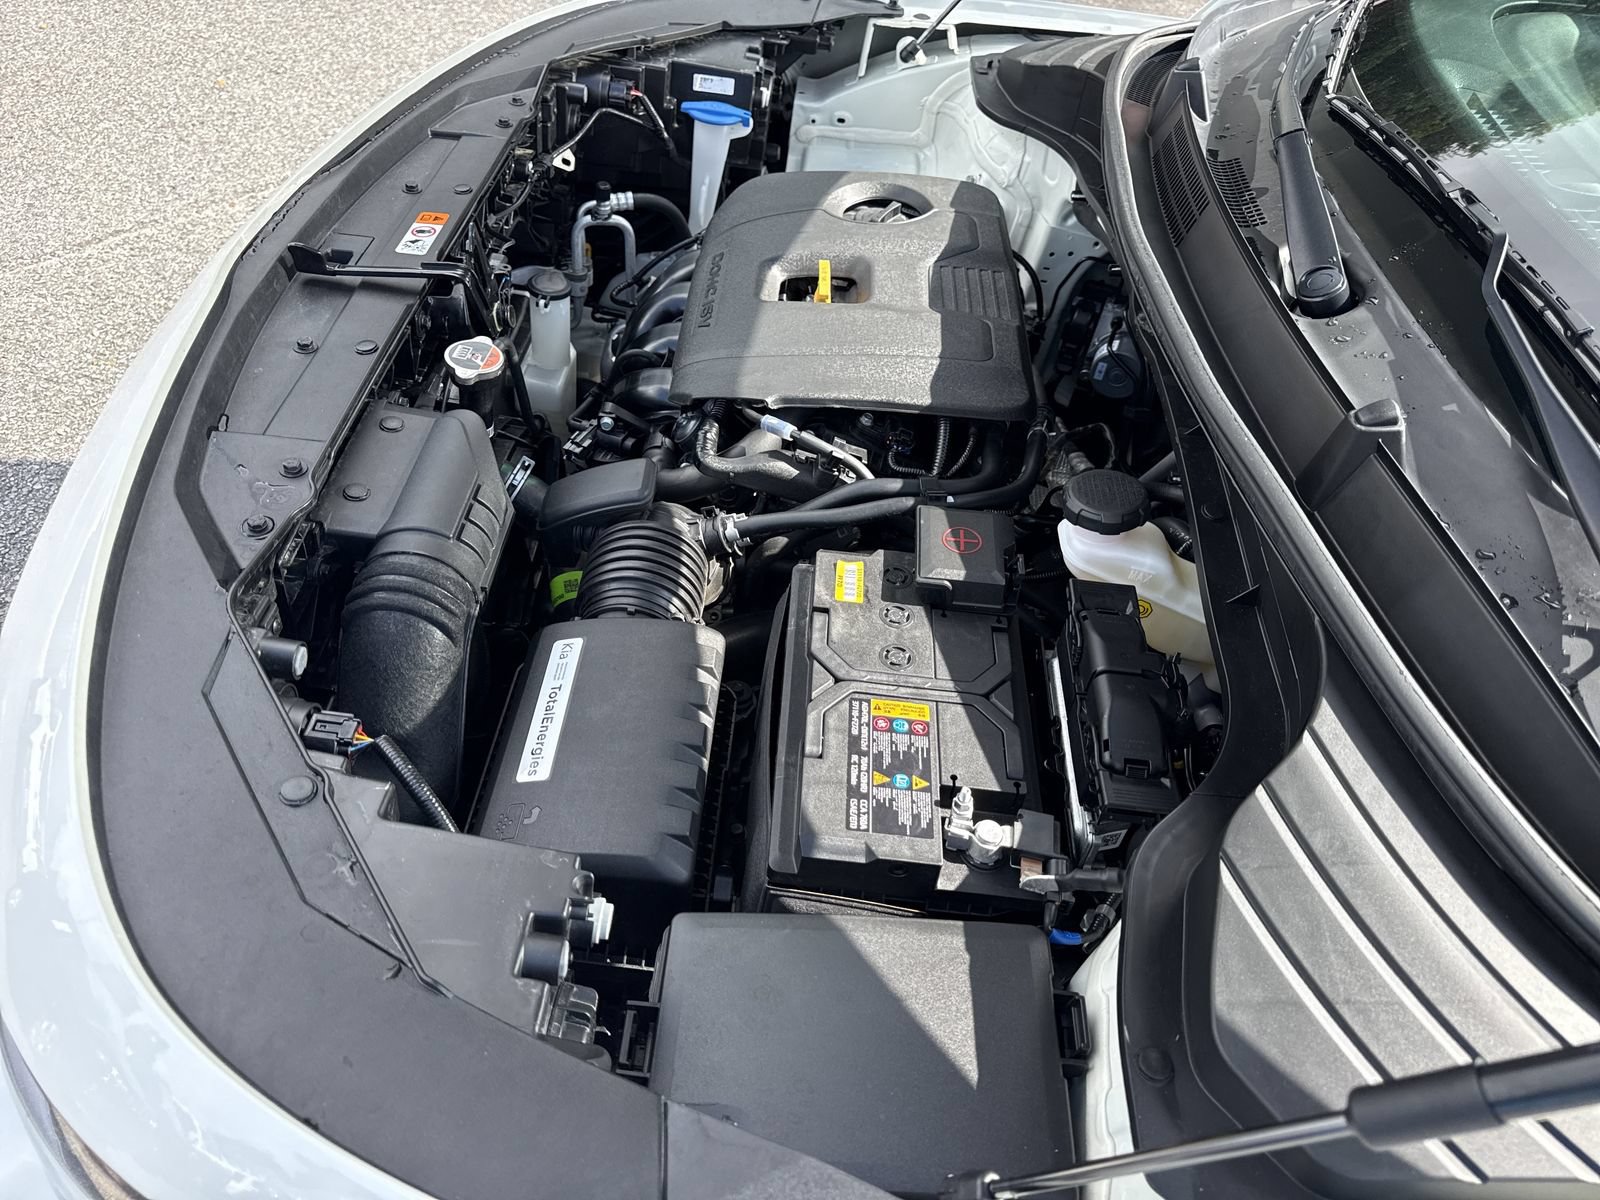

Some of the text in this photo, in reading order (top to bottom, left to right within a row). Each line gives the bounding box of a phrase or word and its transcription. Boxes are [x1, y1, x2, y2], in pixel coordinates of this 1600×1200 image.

[704, 251, 726, 299] DOHC
[527, 641, 575, 777] Kia TotalEnergies
[859, 799, 868, 813] CCA
